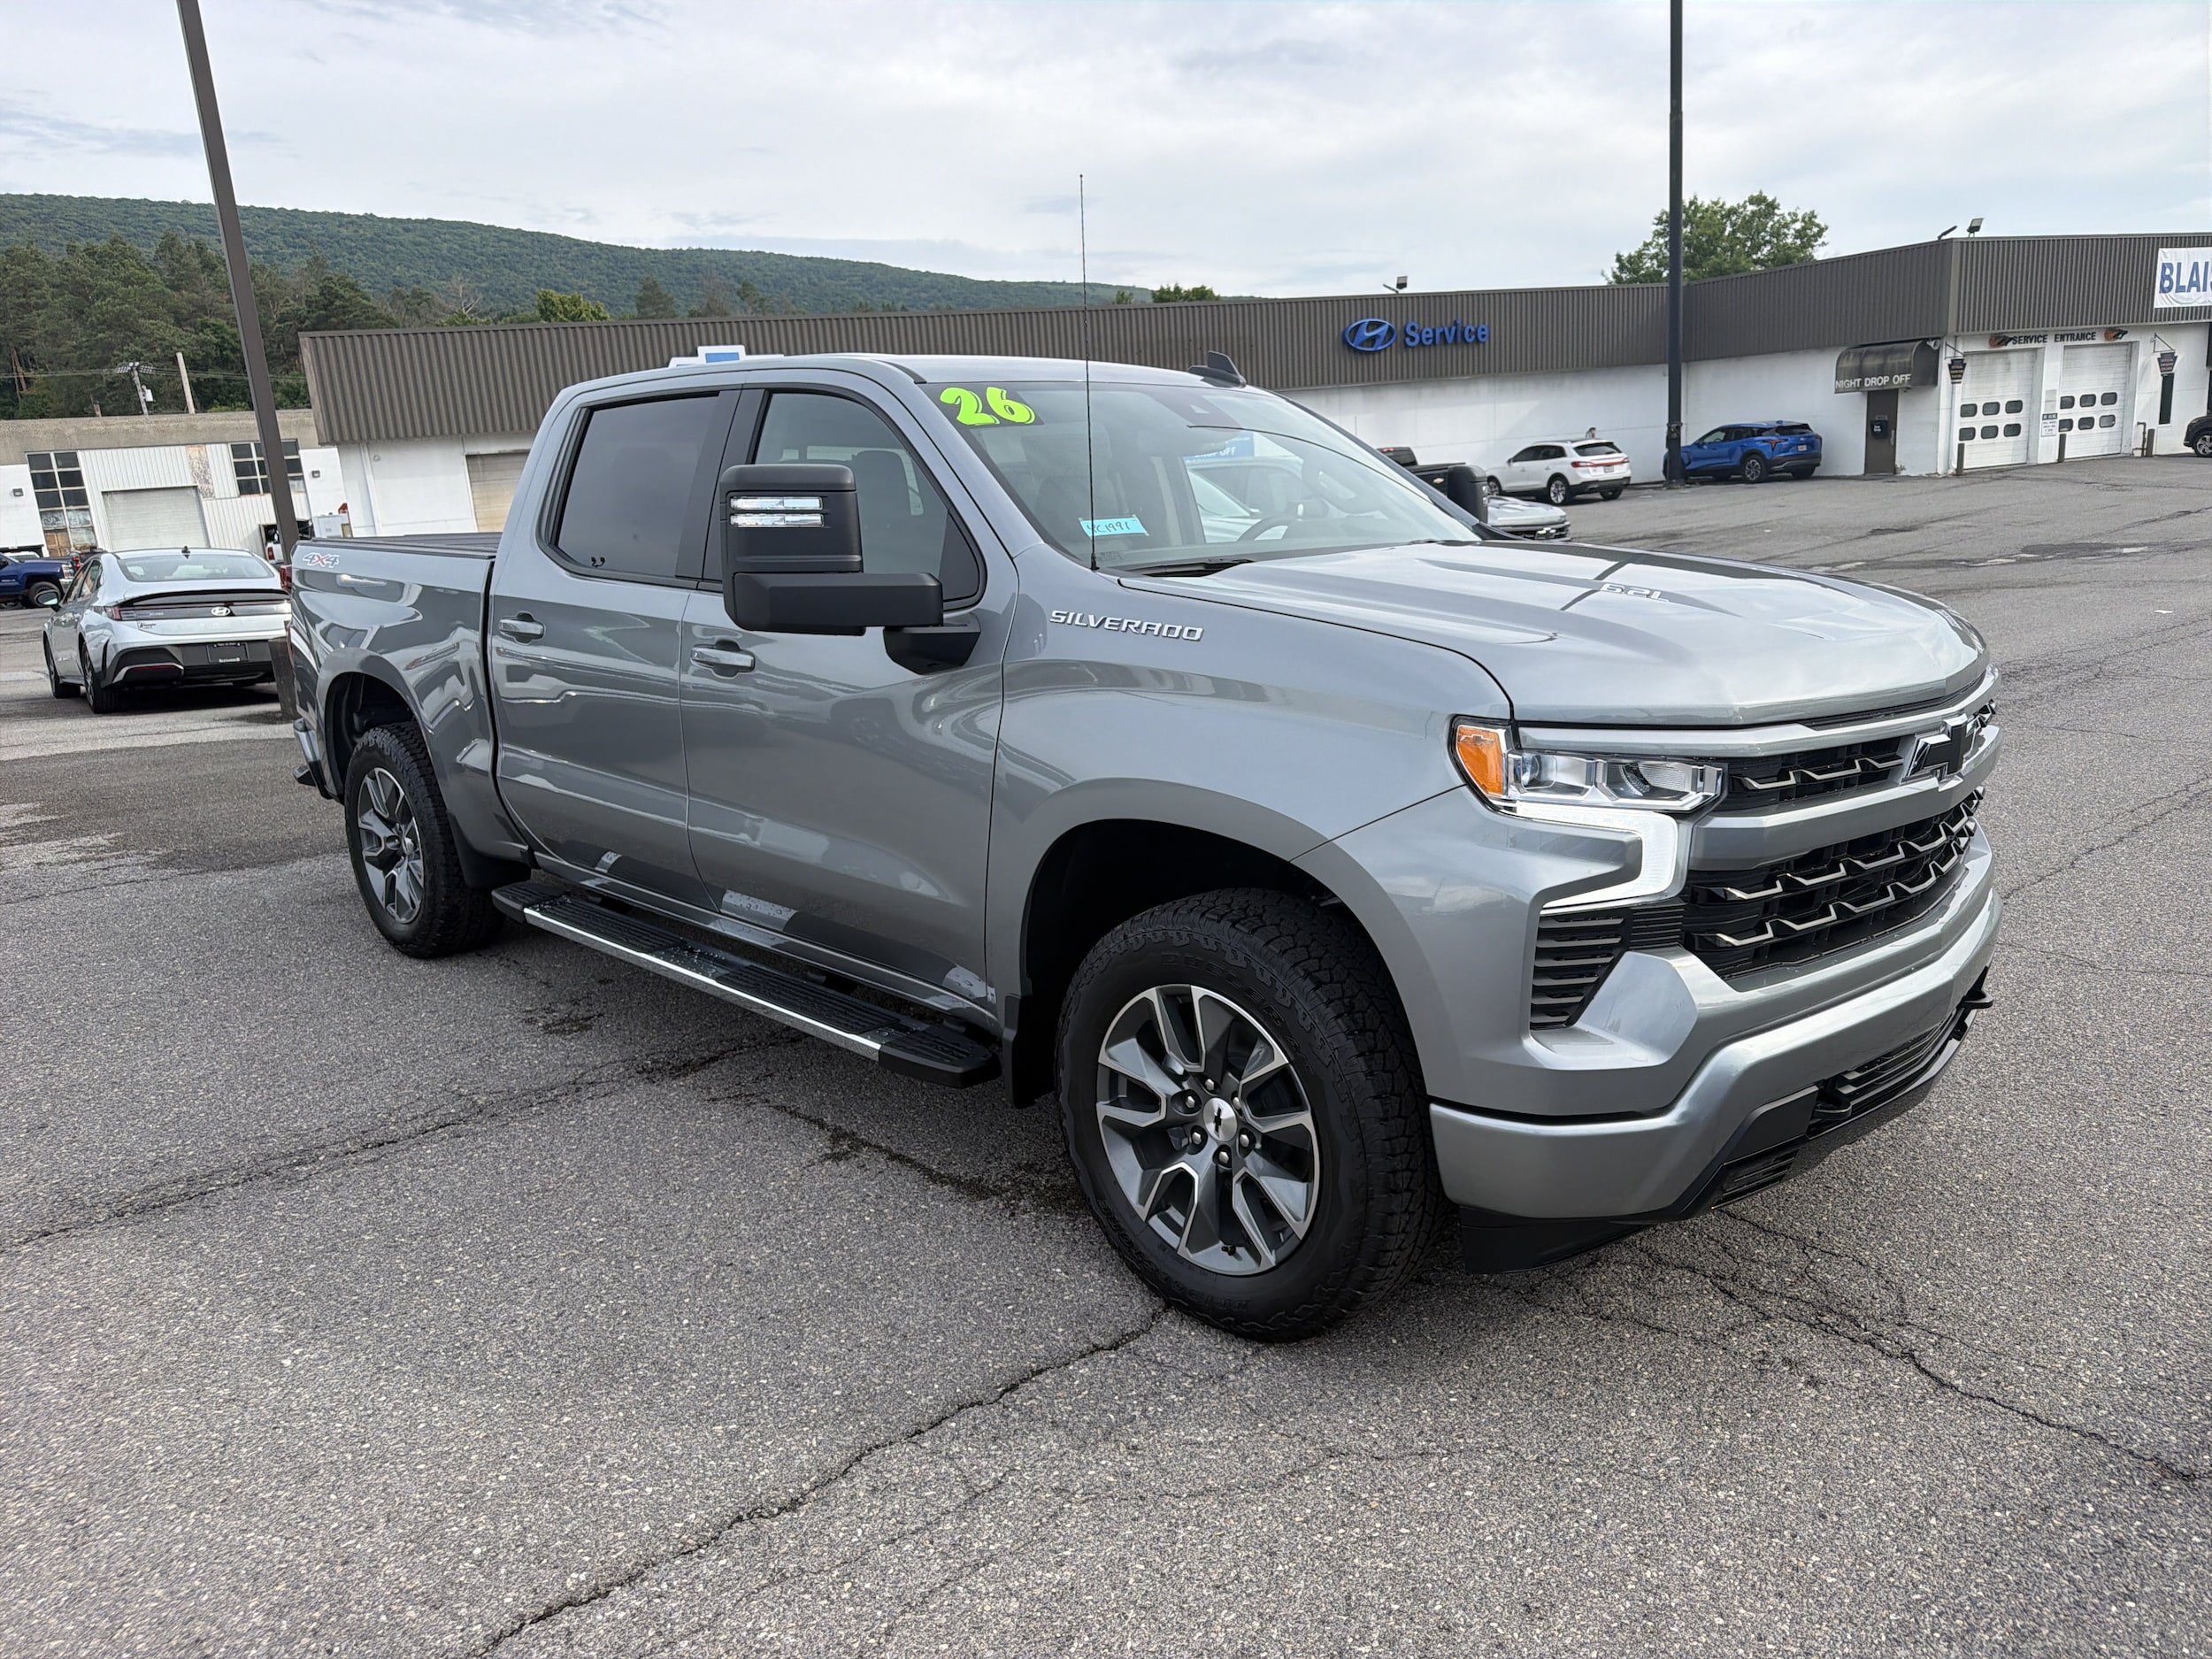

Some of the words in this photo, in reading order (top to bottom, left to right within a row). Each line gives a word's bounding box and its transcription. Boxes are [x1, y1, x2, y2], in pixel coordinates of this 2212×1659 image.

[2159, 261, 2212, 294] BLAI
[1403, 319, 1490, 348] Service
[2012, 334, 2048, 345] SERVICE
[2054, 332, 2097, 343] ENTRANCE
[1835, 378, 1863, 389] NIGHT
[1864, 375, 1890, 388] DROP
[1892, 373, 1912, 385] OFF
[940, 387, 1036, 426] 26
[1049, 610, 1204, 641] SILVERADO
